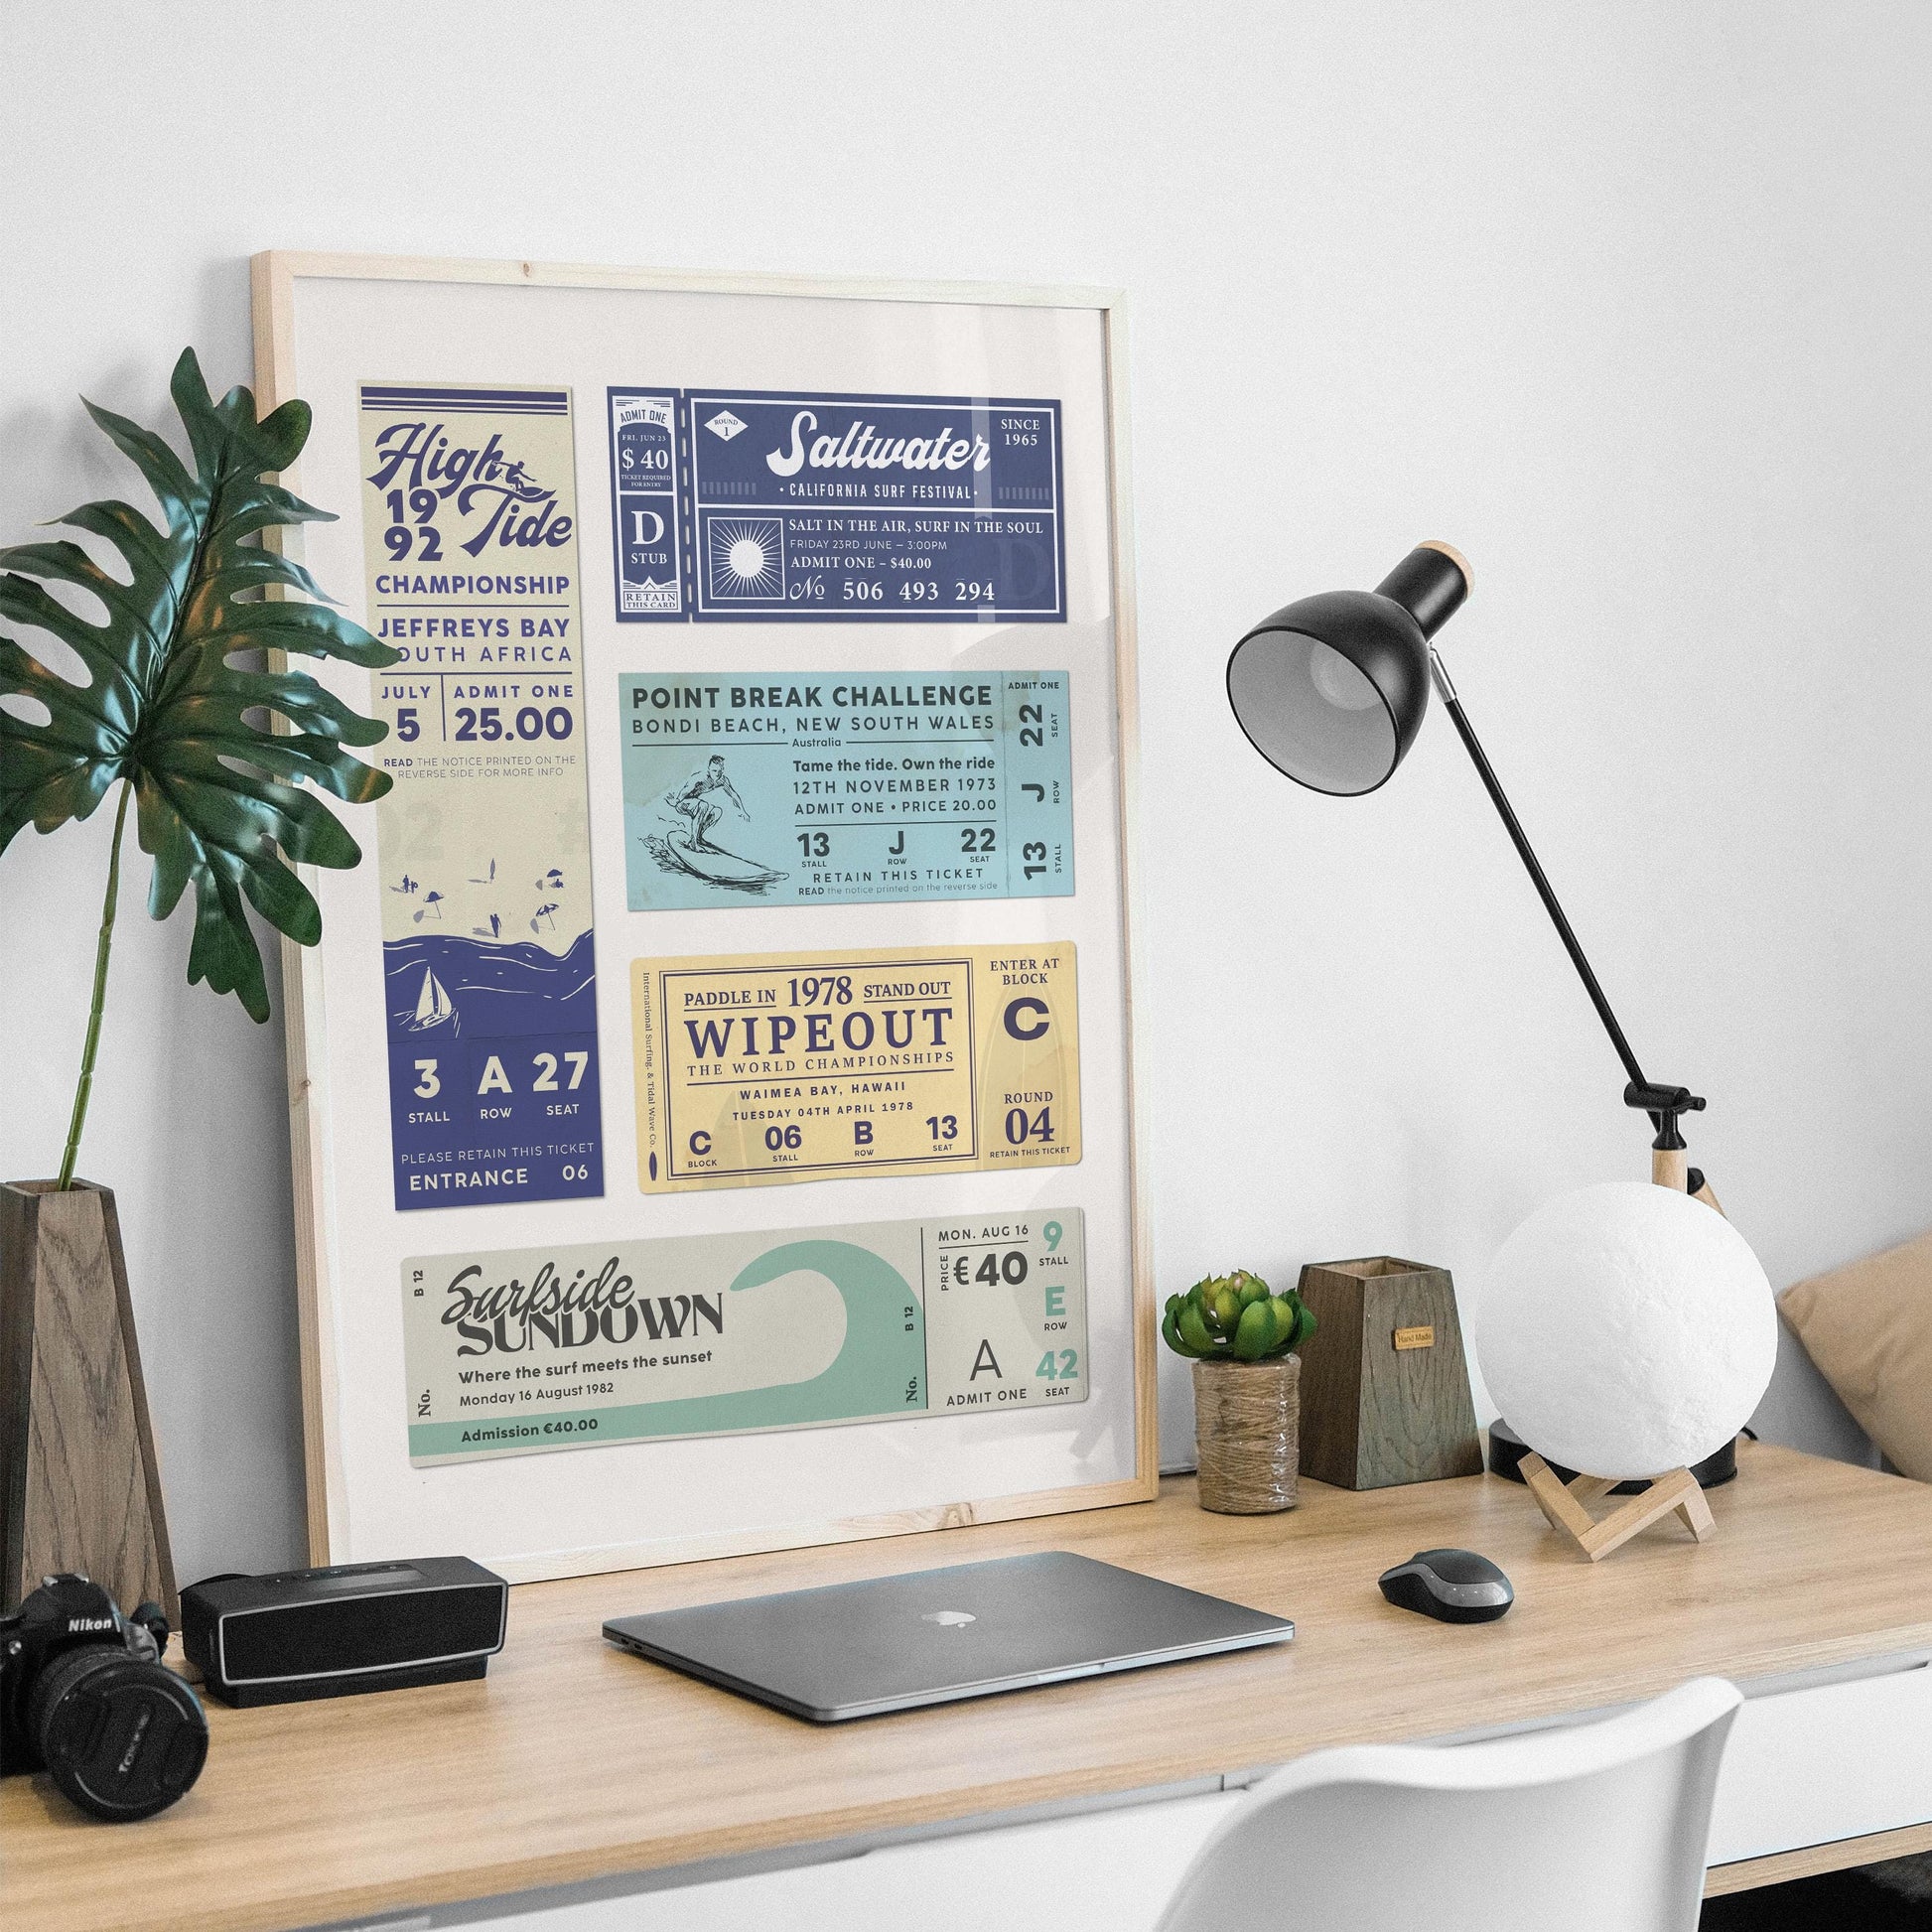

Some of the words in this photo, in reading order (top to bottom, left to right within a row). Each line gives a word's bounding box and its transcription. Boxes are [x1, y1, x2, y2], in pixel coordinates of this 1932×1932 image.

[621, 409, 646, 423] ADMIT
[649, 410, 667, 424] ONE
[714, 417, 739, 426] ROUND
[1001, 418, 1040, 431] SINCE
[765, 410, 991, 478] Saltwater
[1005, 433, 1038, 447] 1965
[365, 422, 503, 499] High
[622, 448, 634, 471] $
[640, 450, 668, 470] 40
[789, 483, 867, 496] CALIFORNIA
[874, 485, 905, 498] SURF
[912, 486, 971, 499] FESTIVAL
[387, 488, 438, 524] 19
[458, 483, 572, 558] Tide
[630, 511, 664, 544] D
[789, 519, 823, 531] SALT
[827, 520, 844, 531] IN
[847, 520, 878, 532] THE
[881, 521, 910, 533] AIR,
[915, 521, 950, 532] SURF
[954, 521, 970, 533] IN
[974, 521, 1003, 533] THE
[1007, 522, 1043, 533] SOUL
[384, 526, 443, 561] 92
[630, 553, 667, 564] STUB
[790, 556, 840, 568] ADMIT
[844, 557, 876, 568] ONE
[891, 557, 931, 570] $40.00
[376, 575, 569, 594] CHAMPIONSHIP
[843, 581, 884, 600] 506
[899, 581, 939, 601] 493
[955, 581, 994, 601] 294
[377, 619, 509, 638] JEFFREYS
[521, 619, 570, 637] BAY
[397, 647, 465, 662] OUTH
[481, 646, 571, 662] AFRICA
[381, 686, 430, 699] JULY
[454, 686, 520, 699] ADMIT
[532, 685, 573, 698] ONE
[632, 687, 719, 708] POINT
[731, 686, 822, 708] BREAK
[832, 685, 992, 707] CHALLENGE
[397, 708, 420, 742] 5
[455, 707, 573, 742] 25.00
[632, 719, 700, 734] BONDI
[711, 718, 786, 734] BEACH,
[796, 717, 841, 731] NEW
[851, 717, 918, 731] SOUTH
[929, 716, 994, 730] WALES
[792, 738, 842, 748] Australia
[793, 760, 833, 772] Tame
[838, 759, 861, 771] the
[865, 759, 897, 771] tide.
[901, 759, 935, 770] Own
[939, 758, 962, 769] the
[966, 757, 995, 768] ride
[794, 781, 836, 794] 12TH
[846, 779, 949, 793] NOVEMBER
[958, 778, 996, 791] 1973
[794, 803, 845, 814] ADMIT
[851, 802, 884, 813] ONE
[902, 800, 946, 812] PRICE
[952, 799, 996, 811] 20.00
[990, 959, 1037, 971] ENTER
[1042, 958, 1059, 969] AT
[1003, 973, 1048, 985] BLOCK
[643, 972, 653, 1032] International
[684, 990, 750, 1007] PADDLE
[757, 989, 776, 1003] IN
[787, 976, 853, 1007] 1978
[863, 983, 914, 998] STAND
[918, 982, 951, 995] OUT
[1004, 997, 1049, 1040] C
[683, 1008, 953, 1058] WIPEOUT
[644, 1035, 653, 1070] Surfing.
[687, 1064, 723, 1076] THE
[733, 1059, 796, 1074] WORLD
[805, 1051, 954, 1070] CHAMPIONSHIPS
[414, 1059, 441, 1099] 3
[478, 1055, 513, 1095] A
[532, 1051, 589, 1092] 27
[740, 1086, 802, 1100] WAIMEA
[810, 1084, 844, 1097] BAY,
[852, 1082, 905, 1094] HAWAII
[1004, 1092, 1053, 1104] ROUND
[409, 1111, 450, 1124] STALL
[481, 1108, 512, 1120] ROW
[546, 1104, 580, 1116] SEAT
[733, 1109, 791, 1121] TUESDAY
[798, 1106, 830, 1117] 04TH
[837, 1104, 876, 1115] APRIL
[882, 1102, 913, 1112] 1978
[854, 1121, 874, 1145] B
[925, 1115, 958, 1140] 13
[1005, 1106, 1054, 1145] 04
[689, 1131, 712, 1156] C
[764, 1125, 802, 1152] 06
[402, 1152, 453, 1165] PLEASE
[458, 1149, 506, 1162] RETAIN
[511, 1146, 542, 1158] THIS
[547, 1143, 595, 1156] TICKET
[688, 1160, 717, 1169] BLOCK
[772, 1154, 798, 1163] STALL
[410, 1169, 528, 1191] ENTRANCE
[562, 1165, 589, 1180] 06
[1043, 1221, 1062, 1252] 9
[953, 1256, 969, 1286] €
[975, 1251, 1029, 1287] 40
[1039, 1257, 1068, 1266] STALL
[413, 1270, 423, 1283] 12
[441, 1256, 635, 1326] Surfside
[1045, 1286, 1066, 1316] E
[457, 1293, 724, 1358] SUNDOWN
[459, 1369, 511, 1384] Where
[515, 1366, 541, 1379] the
[546, 1362, 578, 1377] surf
[582, 1359, 629, 1373] meets
[632, 1356, 657, 1368] the
[662, 1350, 713, 1365] sunset
[969, 1339, 1003, 1381] A
[1035, 1349, 1078, 1380] 42
[418, 1389, 431, 1418] No.
[460, 1391, 515, 1407] Monday
[518, 1389, 532, 1402] 16
[536, 1385, 583, 1402] August
[586, 1383, 614, 1395] 1982
[947, 1392, 992, 1406] ADMIT
[998, 1389, 1027, 1400] ONE
[1045, 1387, 1069, 1397] SEAT
[462, 1425, 539, 1443] Admission
[543, 1419, 599, 1435] €40.00
[69, 1618, 112, 1632] Nikon
